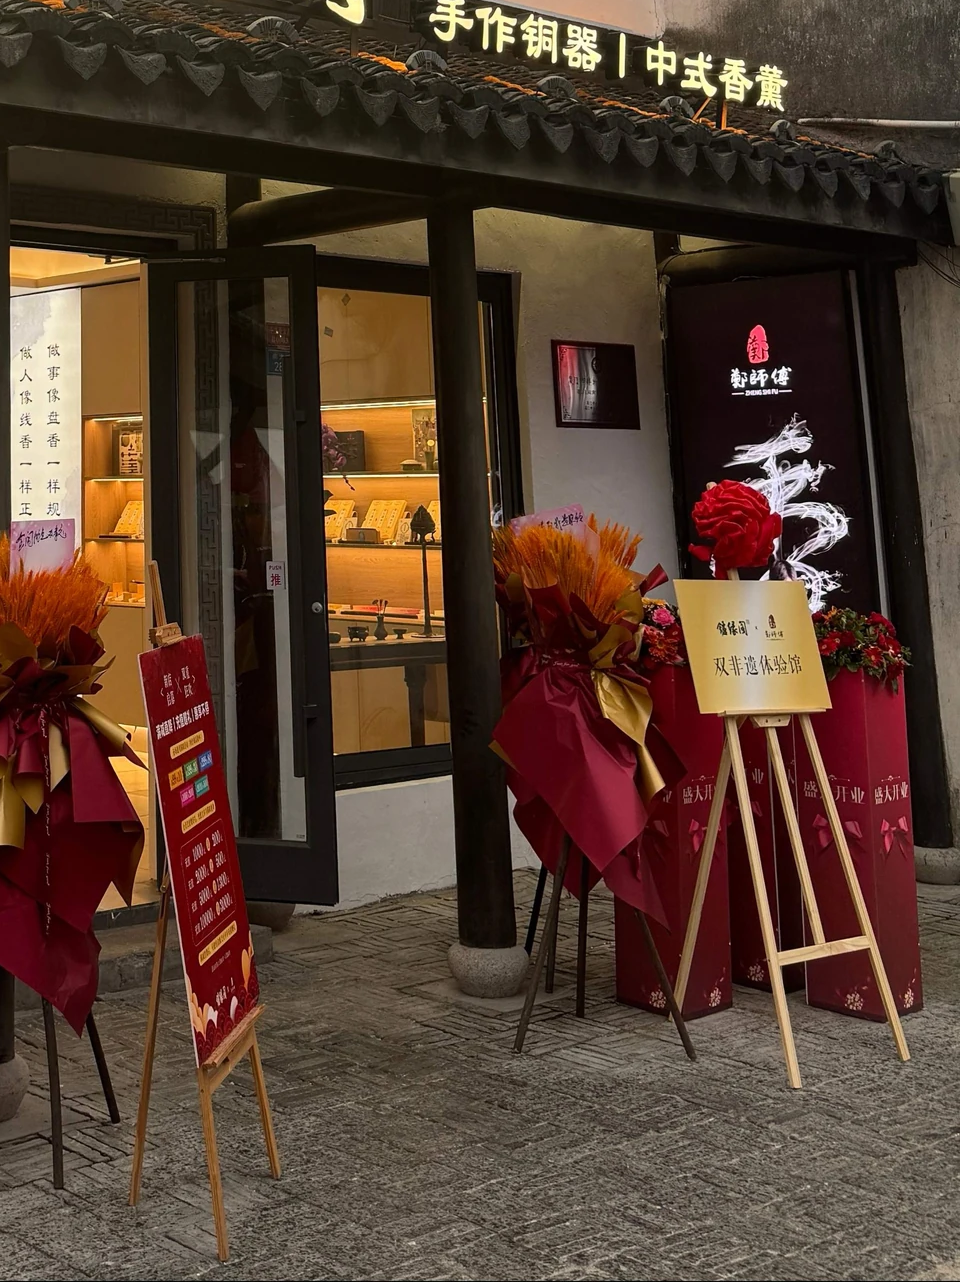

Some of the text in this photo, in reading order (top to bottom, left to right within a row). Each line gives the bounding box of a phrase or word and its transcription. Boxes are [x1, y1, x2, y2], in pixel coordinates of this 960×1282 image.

[271, 573, 282, 587] 推
[713, 653, 802, 677] 双非遗体验馆
[683, 783, 716, 804] 盛大开
[803, 780, 866, 805] 盛开业
[874, 781, 908, 805] 盛大开业
